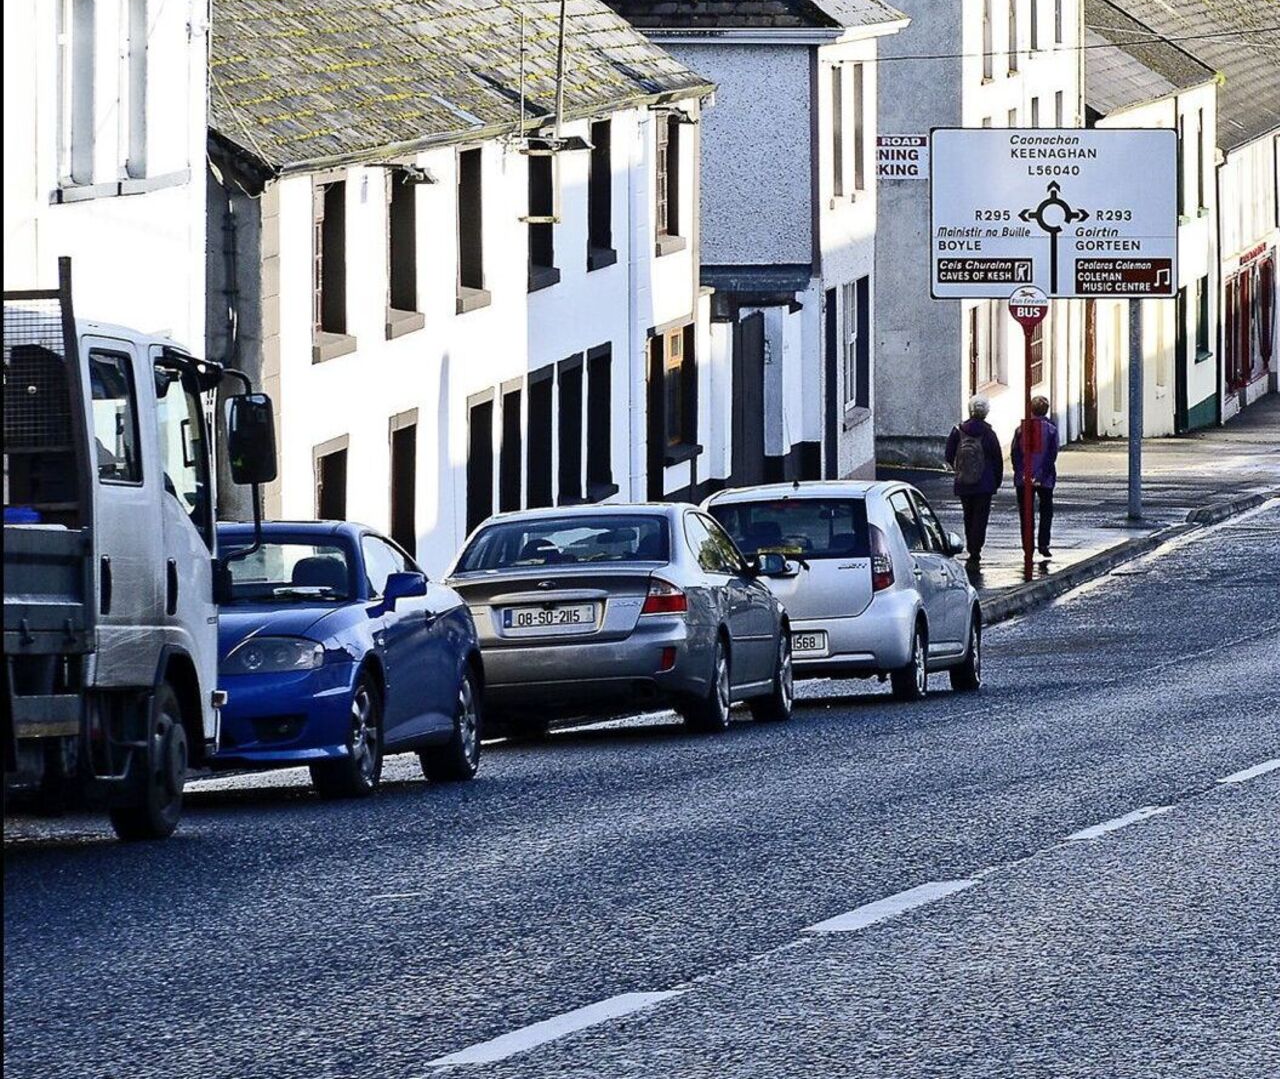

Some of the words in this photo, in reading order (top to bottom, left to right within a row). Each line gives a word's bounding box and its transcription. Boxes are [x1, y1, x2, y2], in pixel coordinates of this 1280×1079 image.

[881, 138, 921, 146] ROAD
[876, 149, 918, 160] NING
[1010, 149, 1097, 158] KEENAGHAN
[876, 164, 918, 175] KING
[1028, 166, 1080, 175] L56040
[975, 210, 1010, 220] R295
[1096, 210, 1132, 220] R293
[937, 226, 981, 237] Mainistir
[1002, 227, 1031, 237] Buille
[938, 241, 982, 250] BOYLE
[1075, 241, 1140, 250] GORTEEN
[1115, 261, 1152, 270] Coleman
[940, 272, 969, 280] CAVES
[972, 272, 984, 280] OF
[987, 272, 1012, 280] KESH
[1077, 272, 1122, 281] COLEMAN
[1083, 282, 1112, 291] MUSIC
[1115, 282, 1151, 291] CENTRE
[1017, 307, 1041, 317] BUS
[793, 636, 816, 648] 1568
